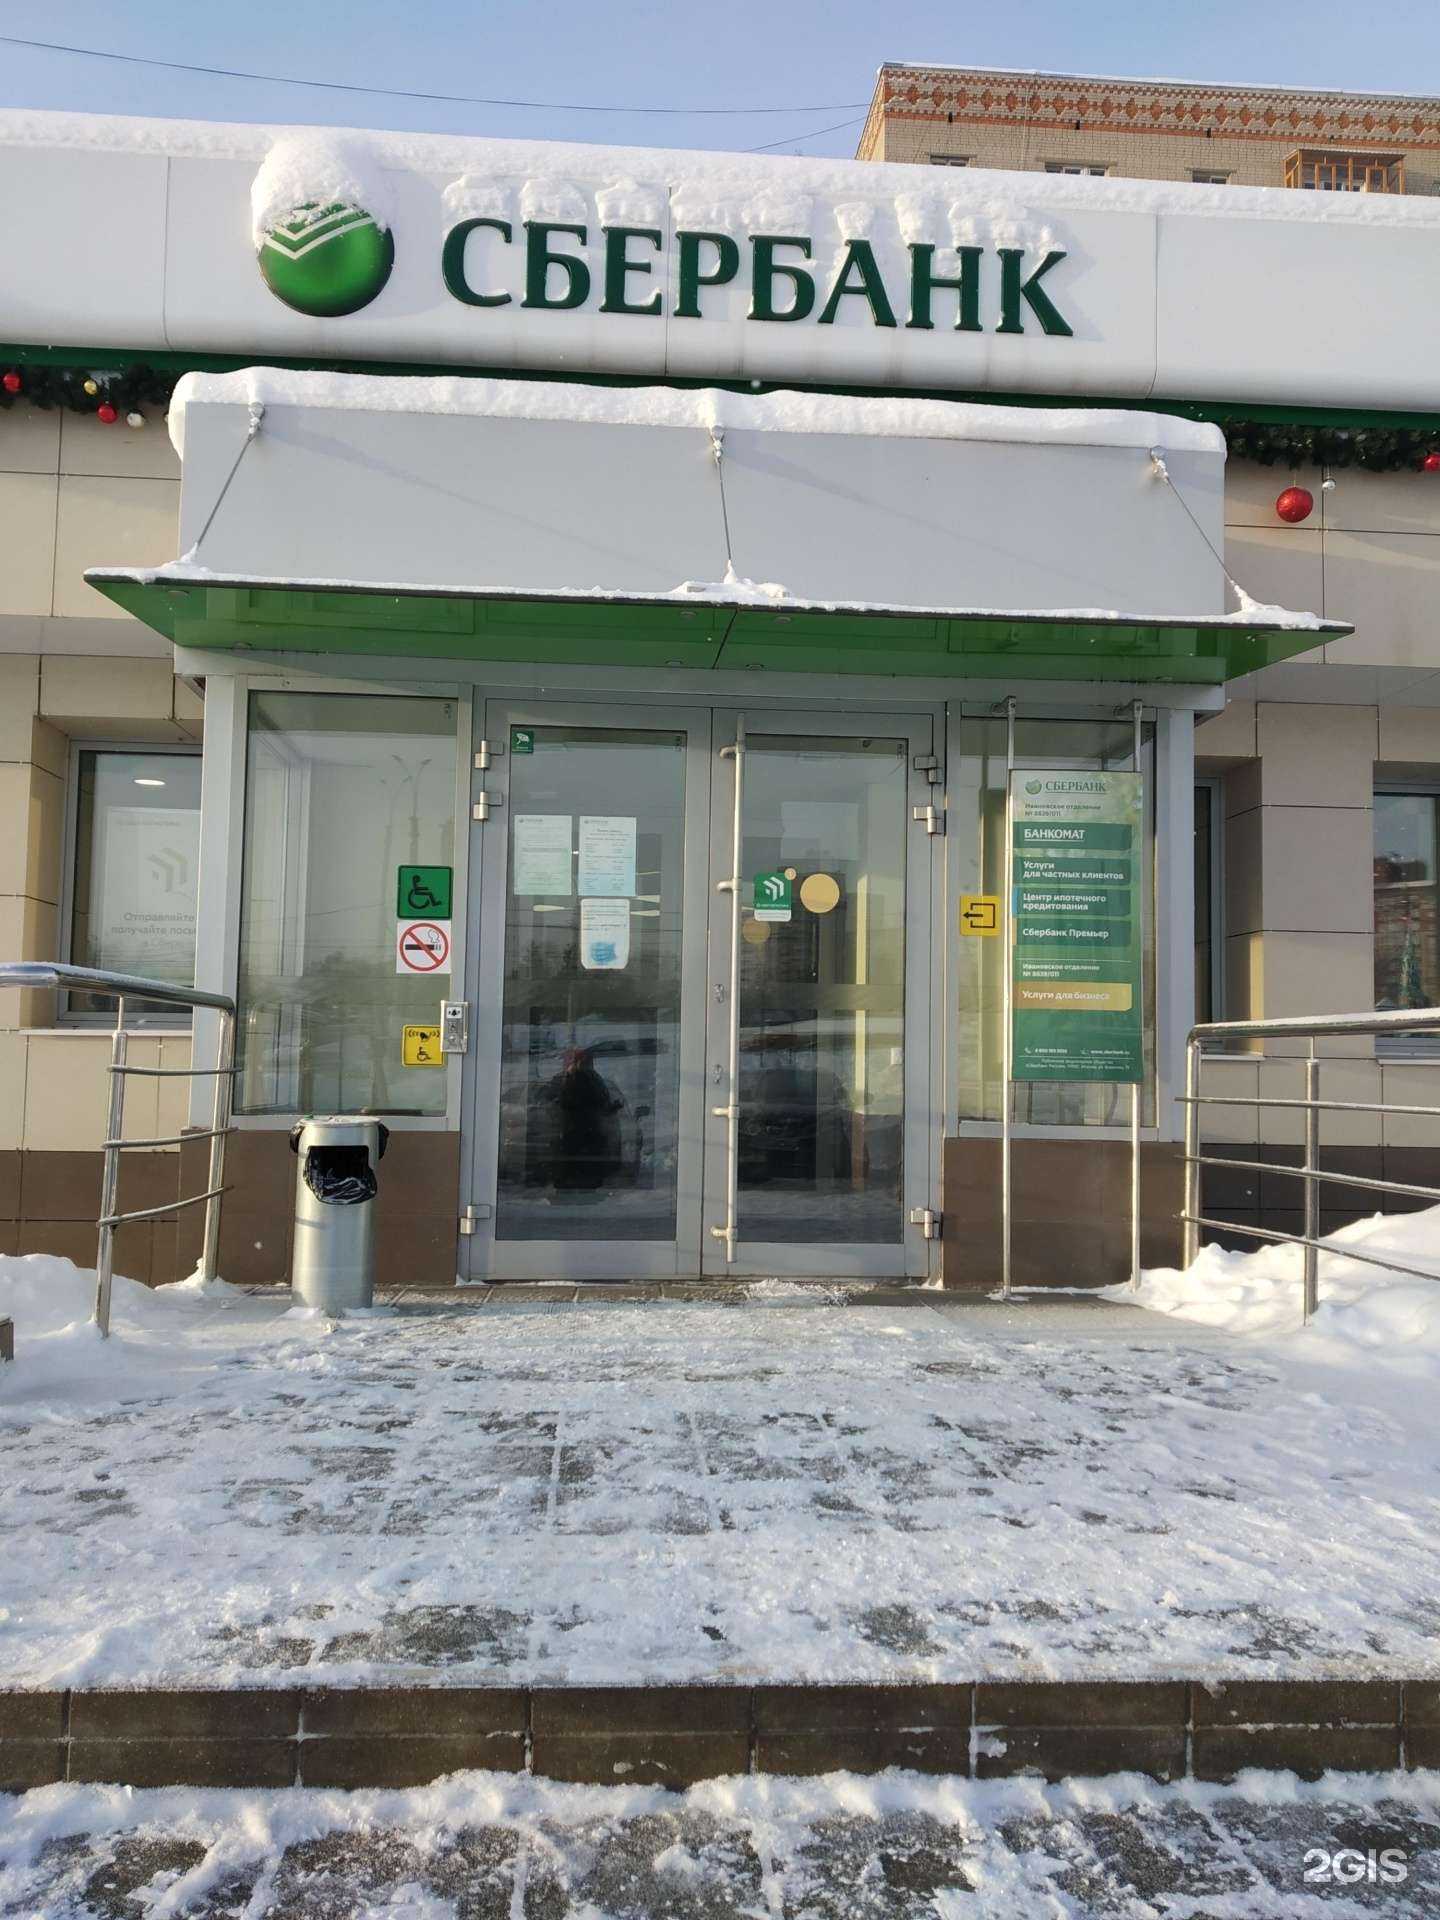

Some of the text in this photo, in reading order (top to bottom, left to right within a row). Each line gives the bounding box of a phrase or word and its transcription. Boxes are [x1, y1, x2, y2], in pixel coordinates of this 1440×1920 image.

[442, 216, 1074, 336] СБЕРБАНК
[1045, 780, 1107, 793] СБЕРБАНК
[1024, 828, 1086, 839] БАНКОМАТ
[1023, 861, 1055, 871] Услуги
[1023, 871, 1125, 880] для частных клиентов
[1023, 893, 1107, 903] Центр ипотечного
[1023, 903, 1089, 912] кредитования
[170, 927, 197, 935] посы
[1022, 928, 1110, 940] Сбербанк Премьер
[1022, 990, 1110, 1000] Услуги для бизнеса
